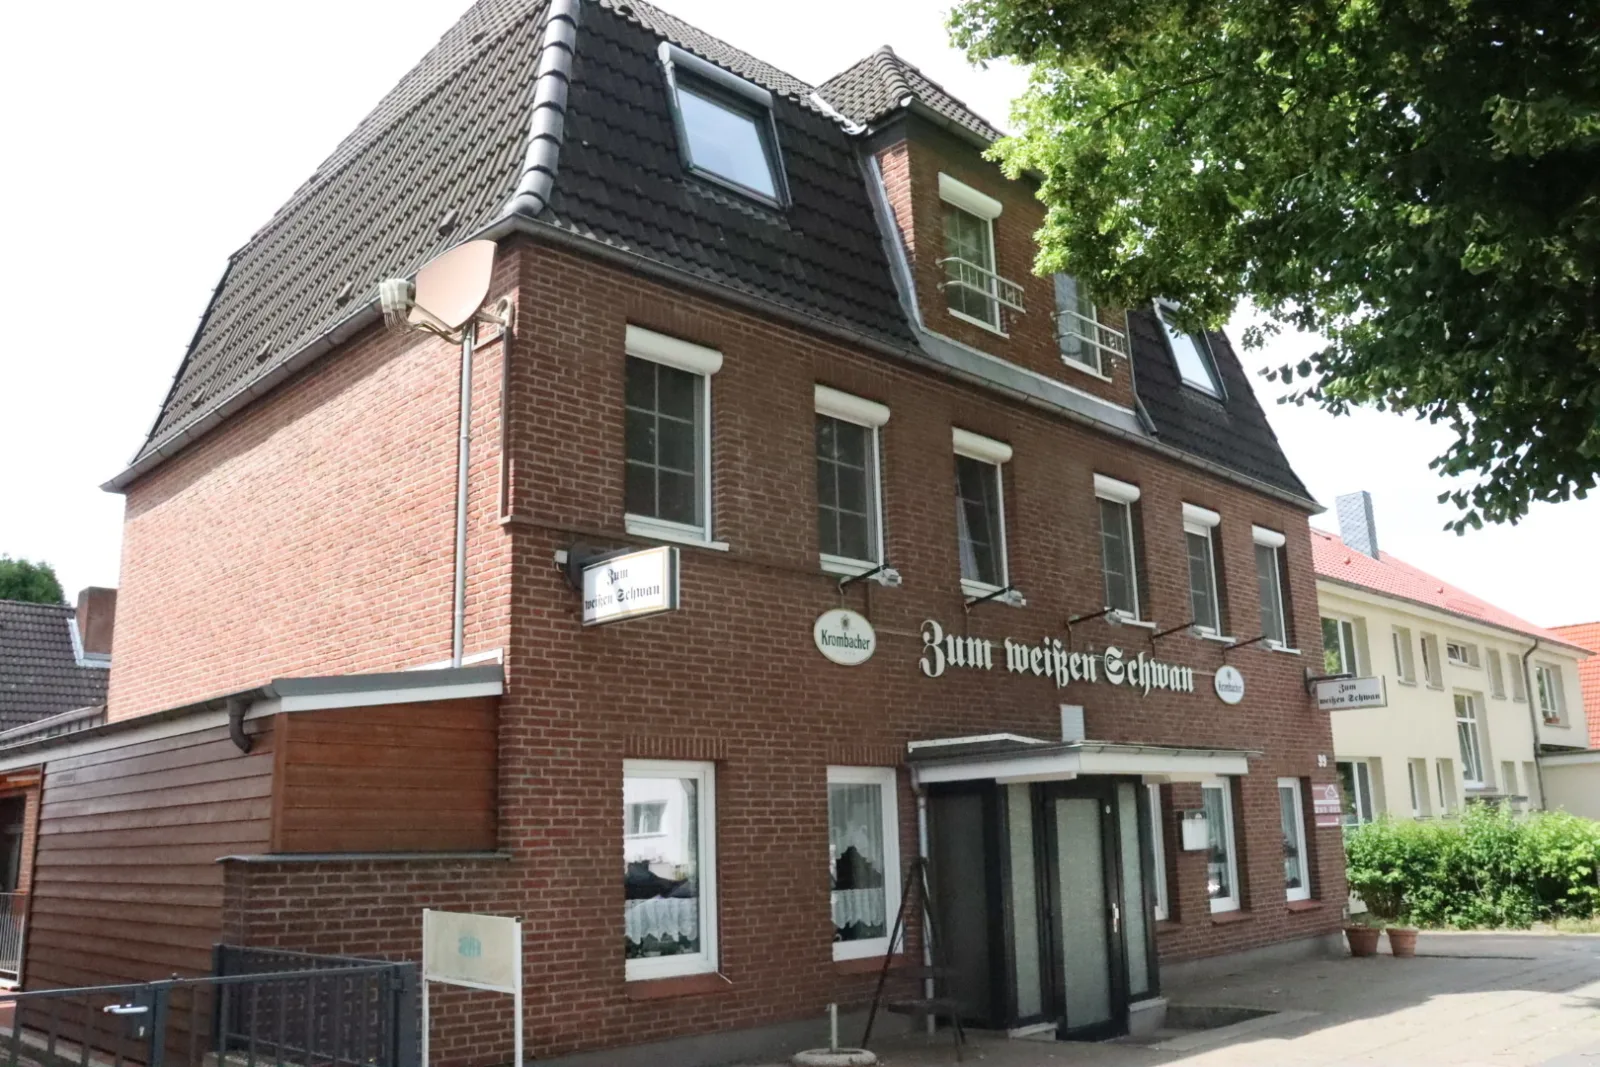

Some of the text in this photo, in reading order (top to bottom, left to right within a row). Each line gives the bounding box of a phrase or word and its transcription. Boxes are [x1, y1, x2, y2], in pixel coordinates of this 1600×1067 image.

[606, 568, 629, 586] Zum
[617, 583, 661, 603] Schwan
[821, 628, 871, 650] Krombacher
[919, 619, 1195, 698] Zum weißen Schwan
[1338, 683, 1357, 694] Zum
[1348, 693, 1380, 703] Schwan
